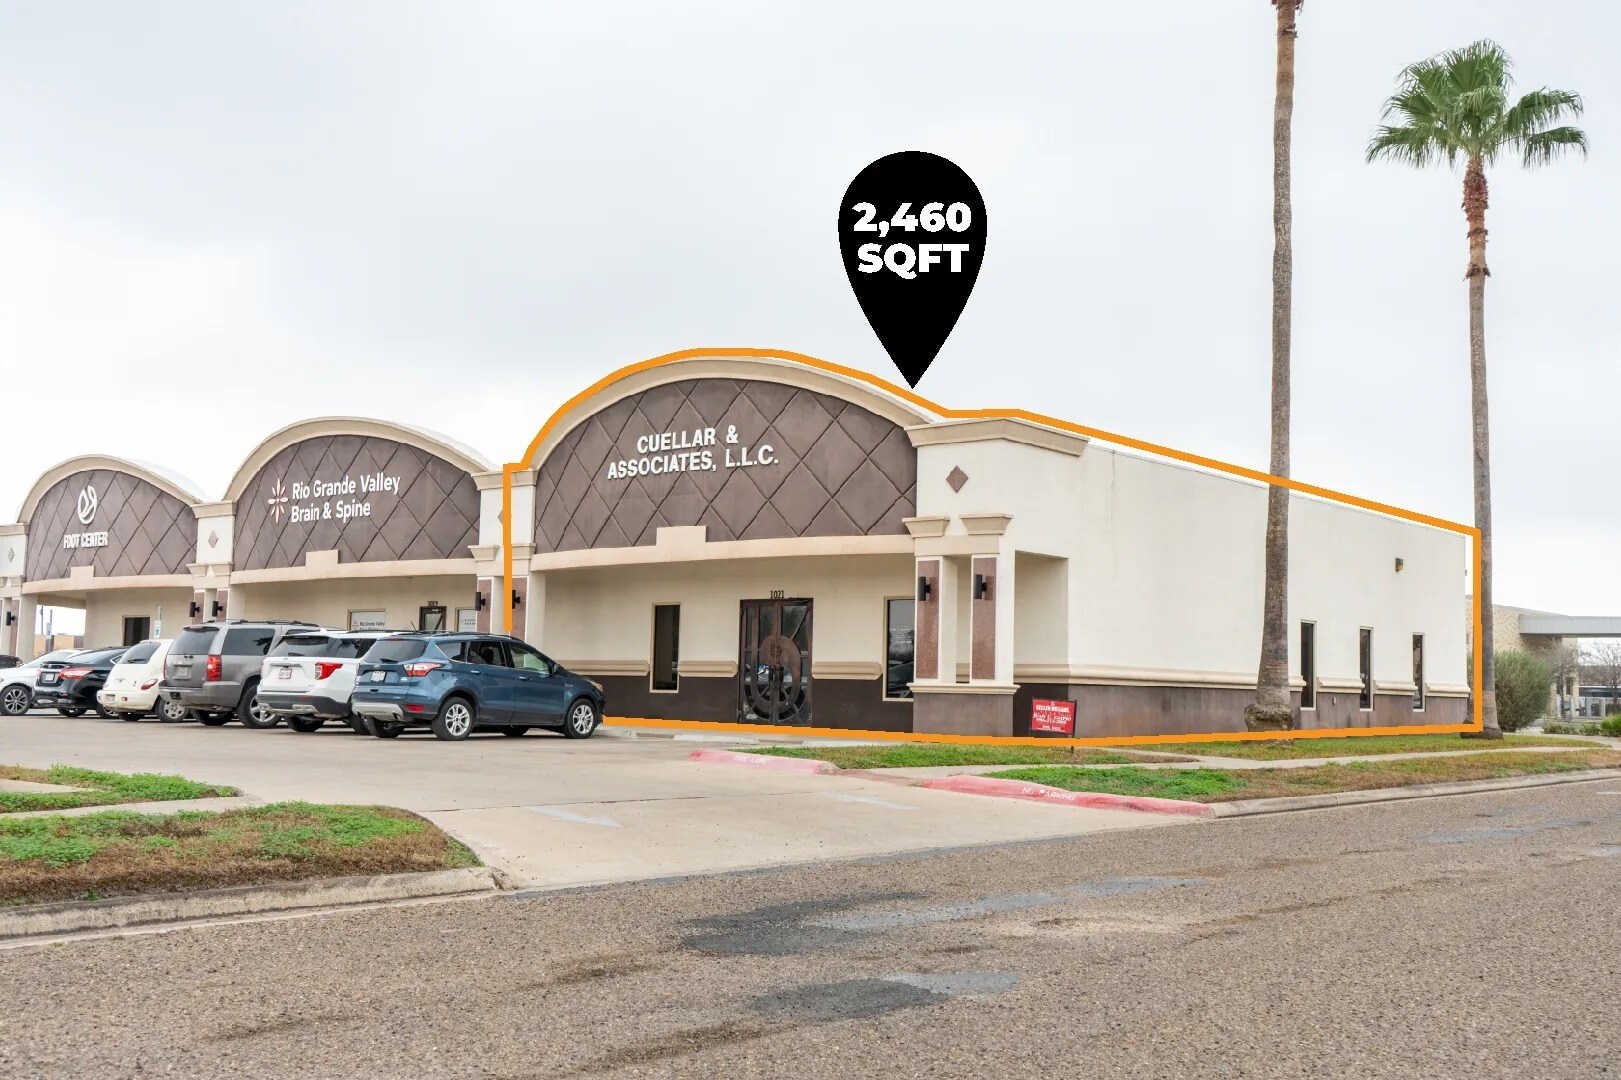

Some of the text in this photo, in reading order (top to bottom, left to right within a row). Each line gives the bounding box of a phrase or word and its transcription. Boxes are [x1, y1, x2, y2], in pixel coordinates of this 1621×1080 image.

[637, 424, 739, 453] CUELLAR &
[607, 444, 779, 480] ASSOCIATES, L.L.C.
[292, 472, 400, 500] Rio Grande Valley
[291, 499, 371, 523] Brain & Spine
[63, 531, 109, 549] FOOT CENTER
[770, 590, 784, 599] 1021
[1039, 789, 1077, 801] PARKING
